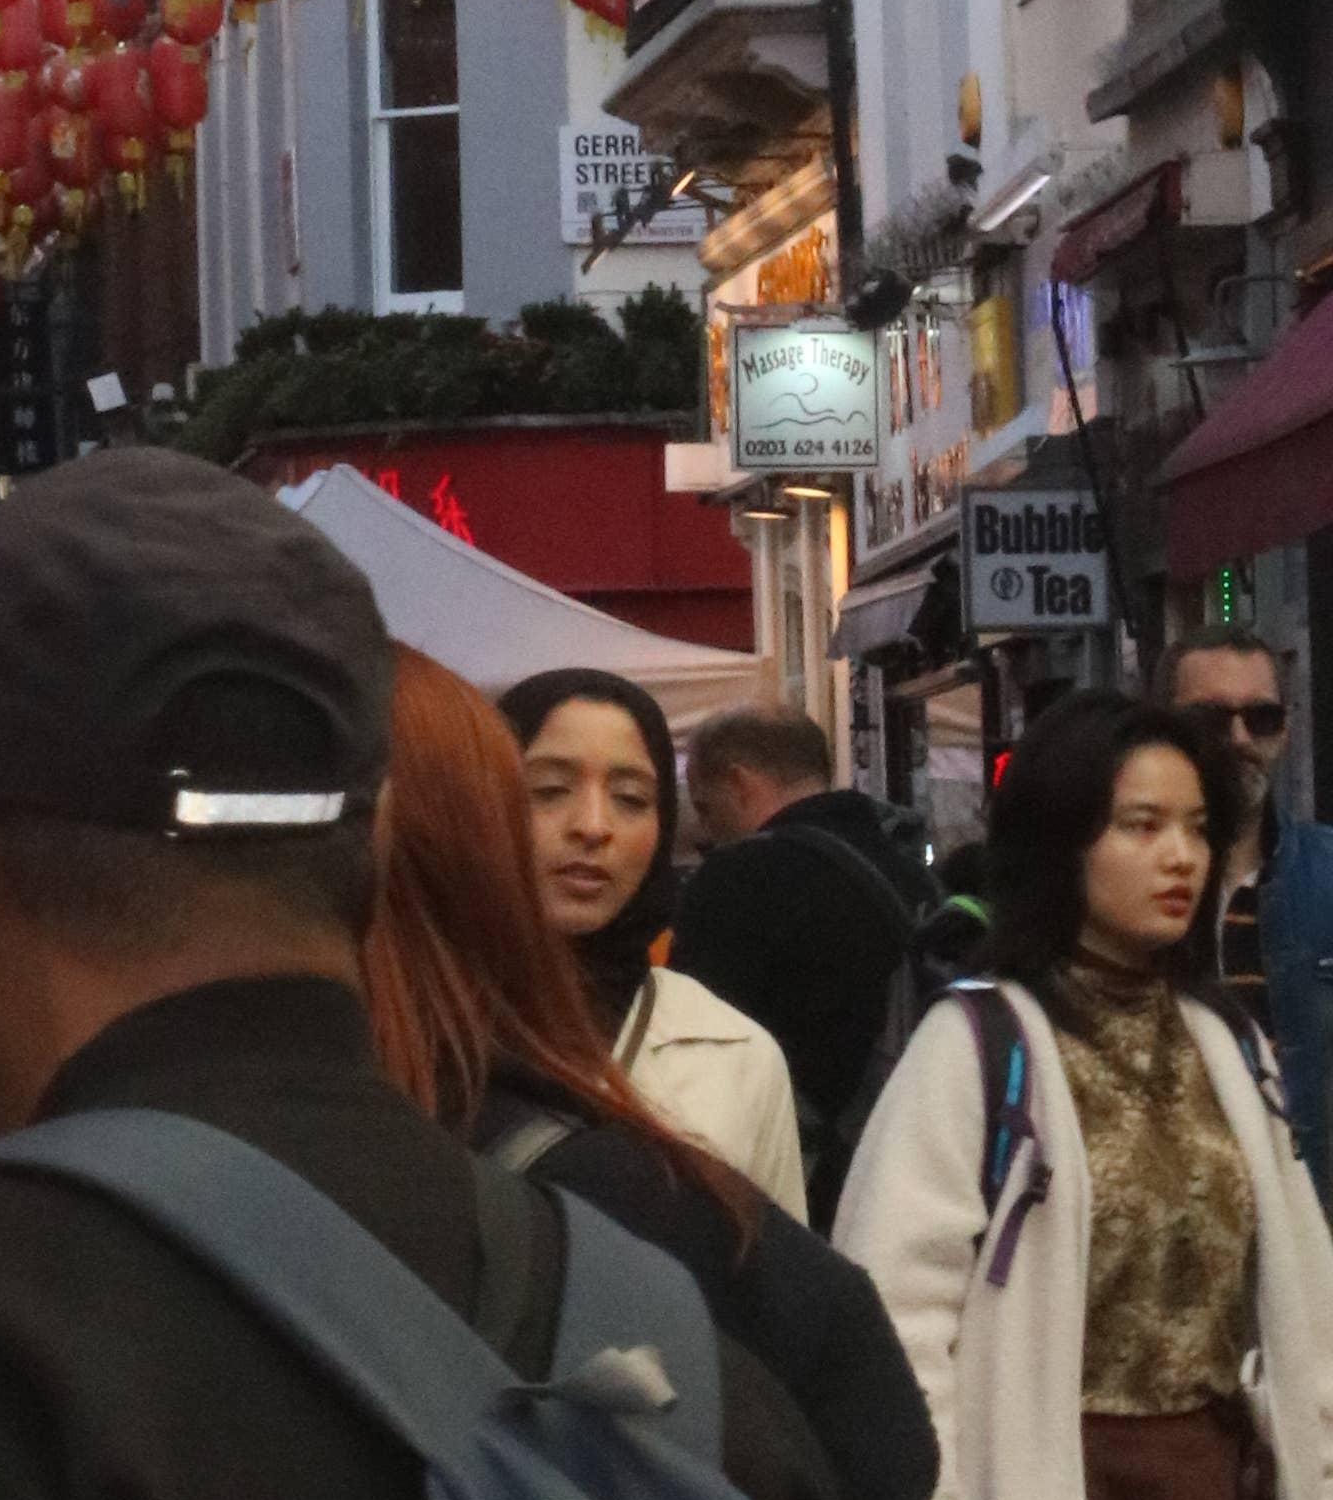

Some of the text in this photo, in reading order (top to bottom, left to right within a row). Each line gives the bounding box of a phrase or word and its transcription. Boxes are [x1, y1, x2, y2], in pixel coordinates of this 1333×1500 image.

[575, 134, 644, 157] GERR
[740, 337, 871, 386] Massage Therapy
[794, 440, 825, 457] 624
[832, 440, 874, 457] 4126
[974, 503, 1103, 555] Bubble
[1026, 564, 1093, 616] Tea
